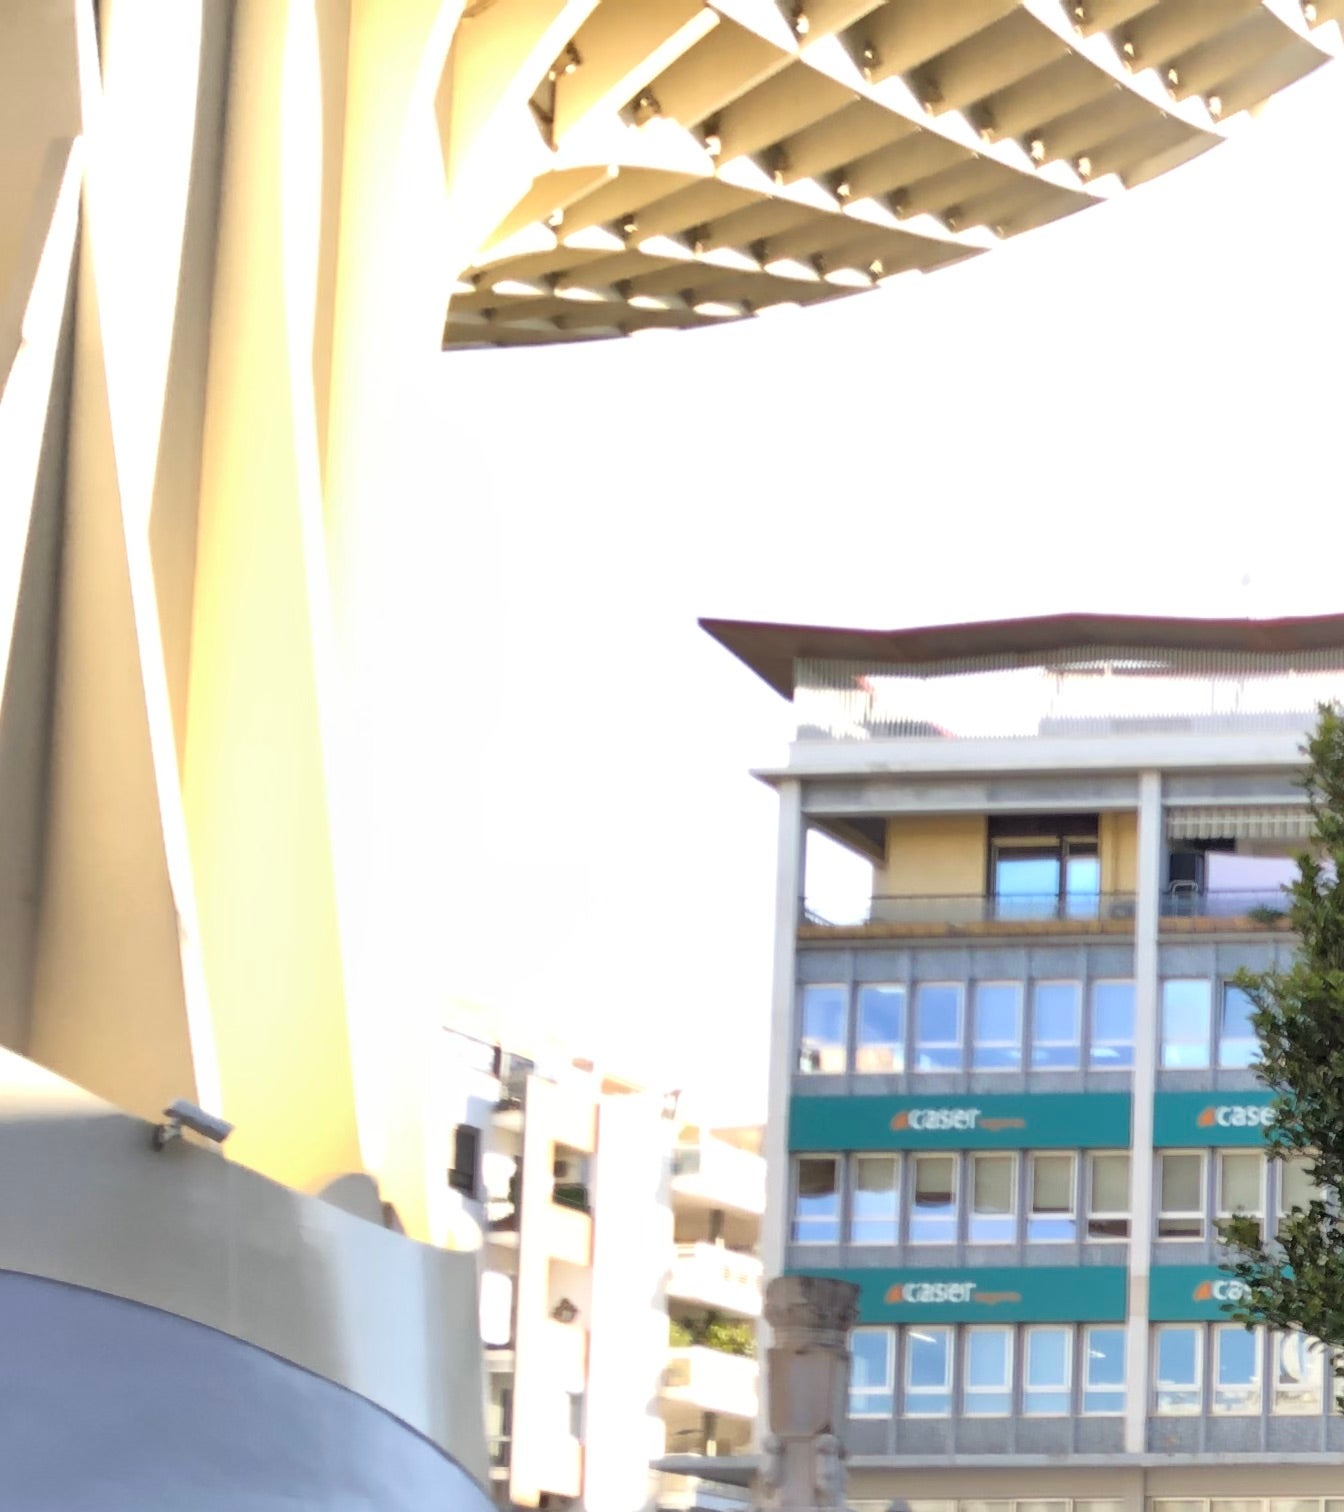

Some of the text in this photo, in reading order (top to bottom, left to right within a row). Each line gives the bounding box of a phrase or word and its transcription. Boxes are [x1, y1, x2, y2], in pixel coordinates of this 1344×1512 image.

[908, 1109, 981, 1129] caser
[1215, 1105, 1277, 1126] case
[902, 1282, 976, 1303] caser
[1213, 1280, 1252, 1301] cas
